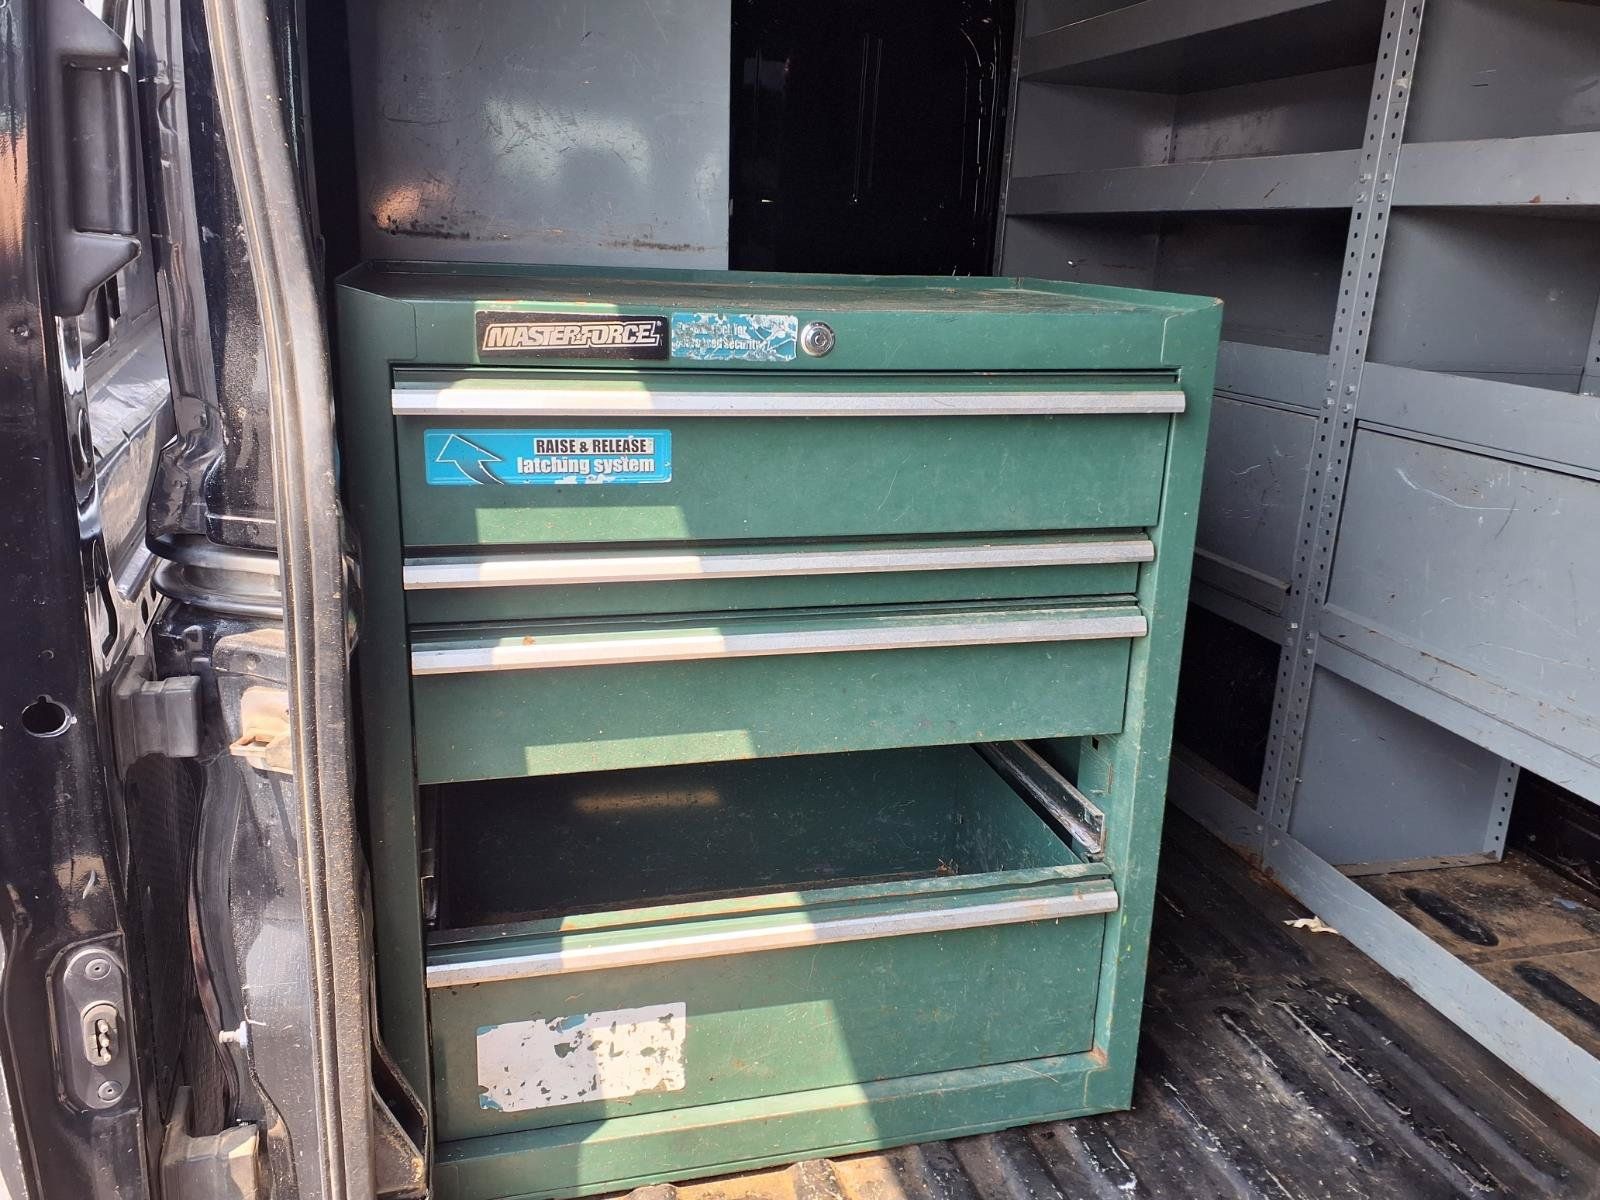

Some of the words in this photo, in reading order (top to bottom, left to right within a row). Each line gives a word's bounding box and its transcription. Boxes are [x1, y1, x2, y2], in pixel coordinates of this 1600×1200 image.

[536, 438, 575, 453] RAISE
[579, 440, 589, 453] &
[592, 438, 646, 453] RELEASE
[517, 456, 590, 475] latching
[594, 456, 655, 474] system
